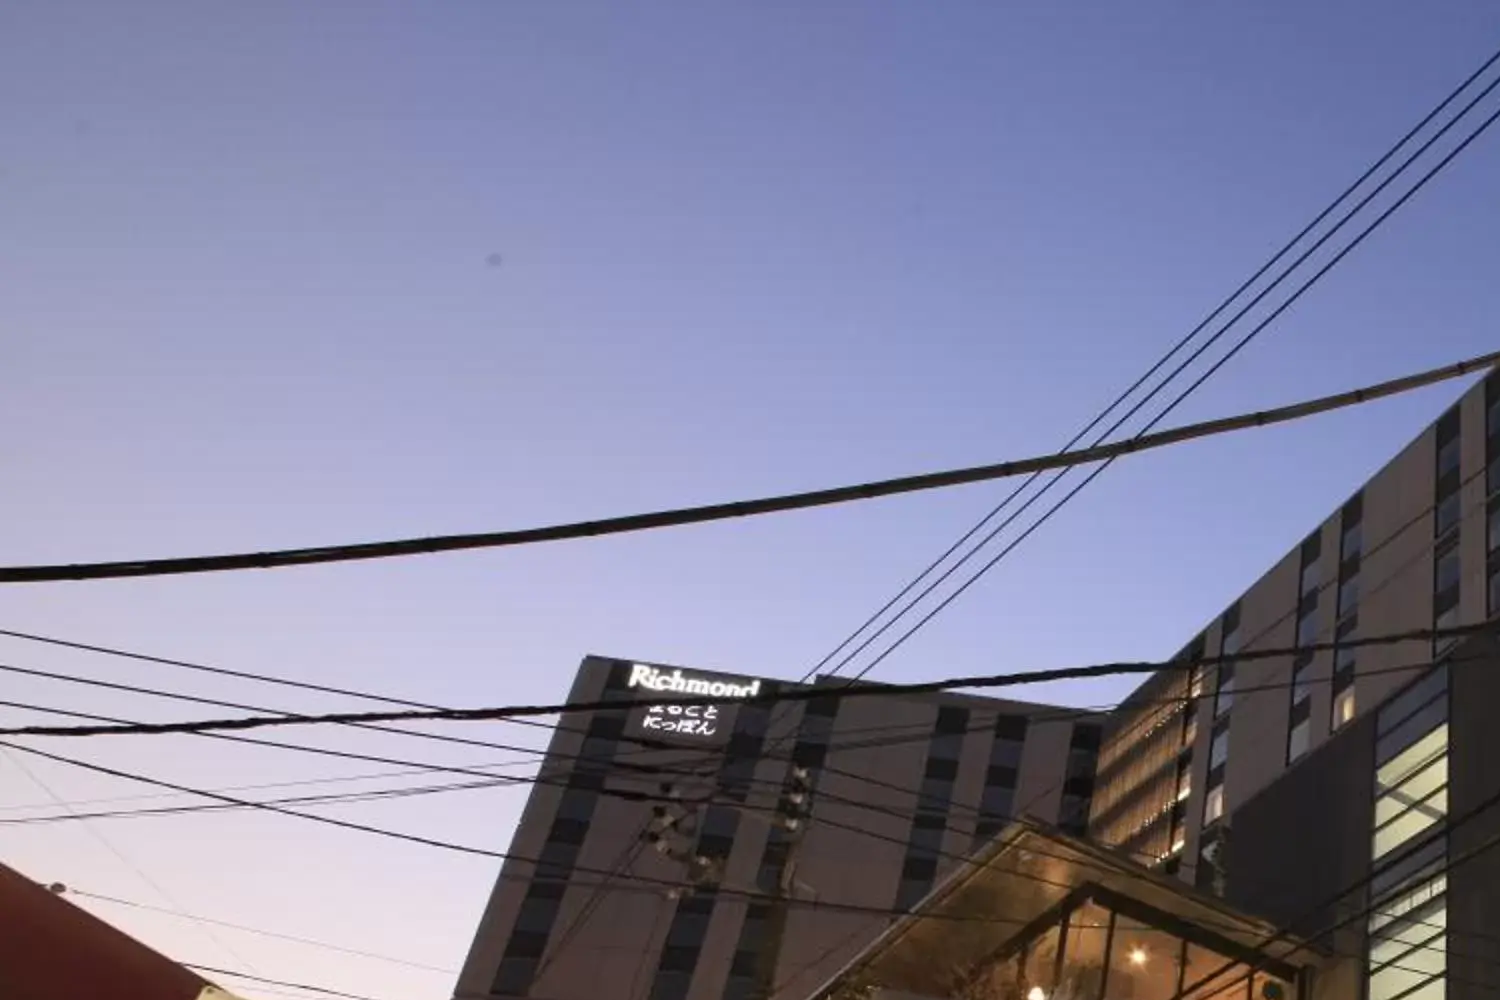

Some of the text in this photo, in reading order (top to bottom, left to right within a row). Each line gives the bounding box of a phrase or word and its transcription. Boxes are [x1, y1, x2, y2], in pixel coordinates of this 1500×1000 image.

[628, 664, 761, 698] Richmond
[642, 714, 716, 736] にっぽん
